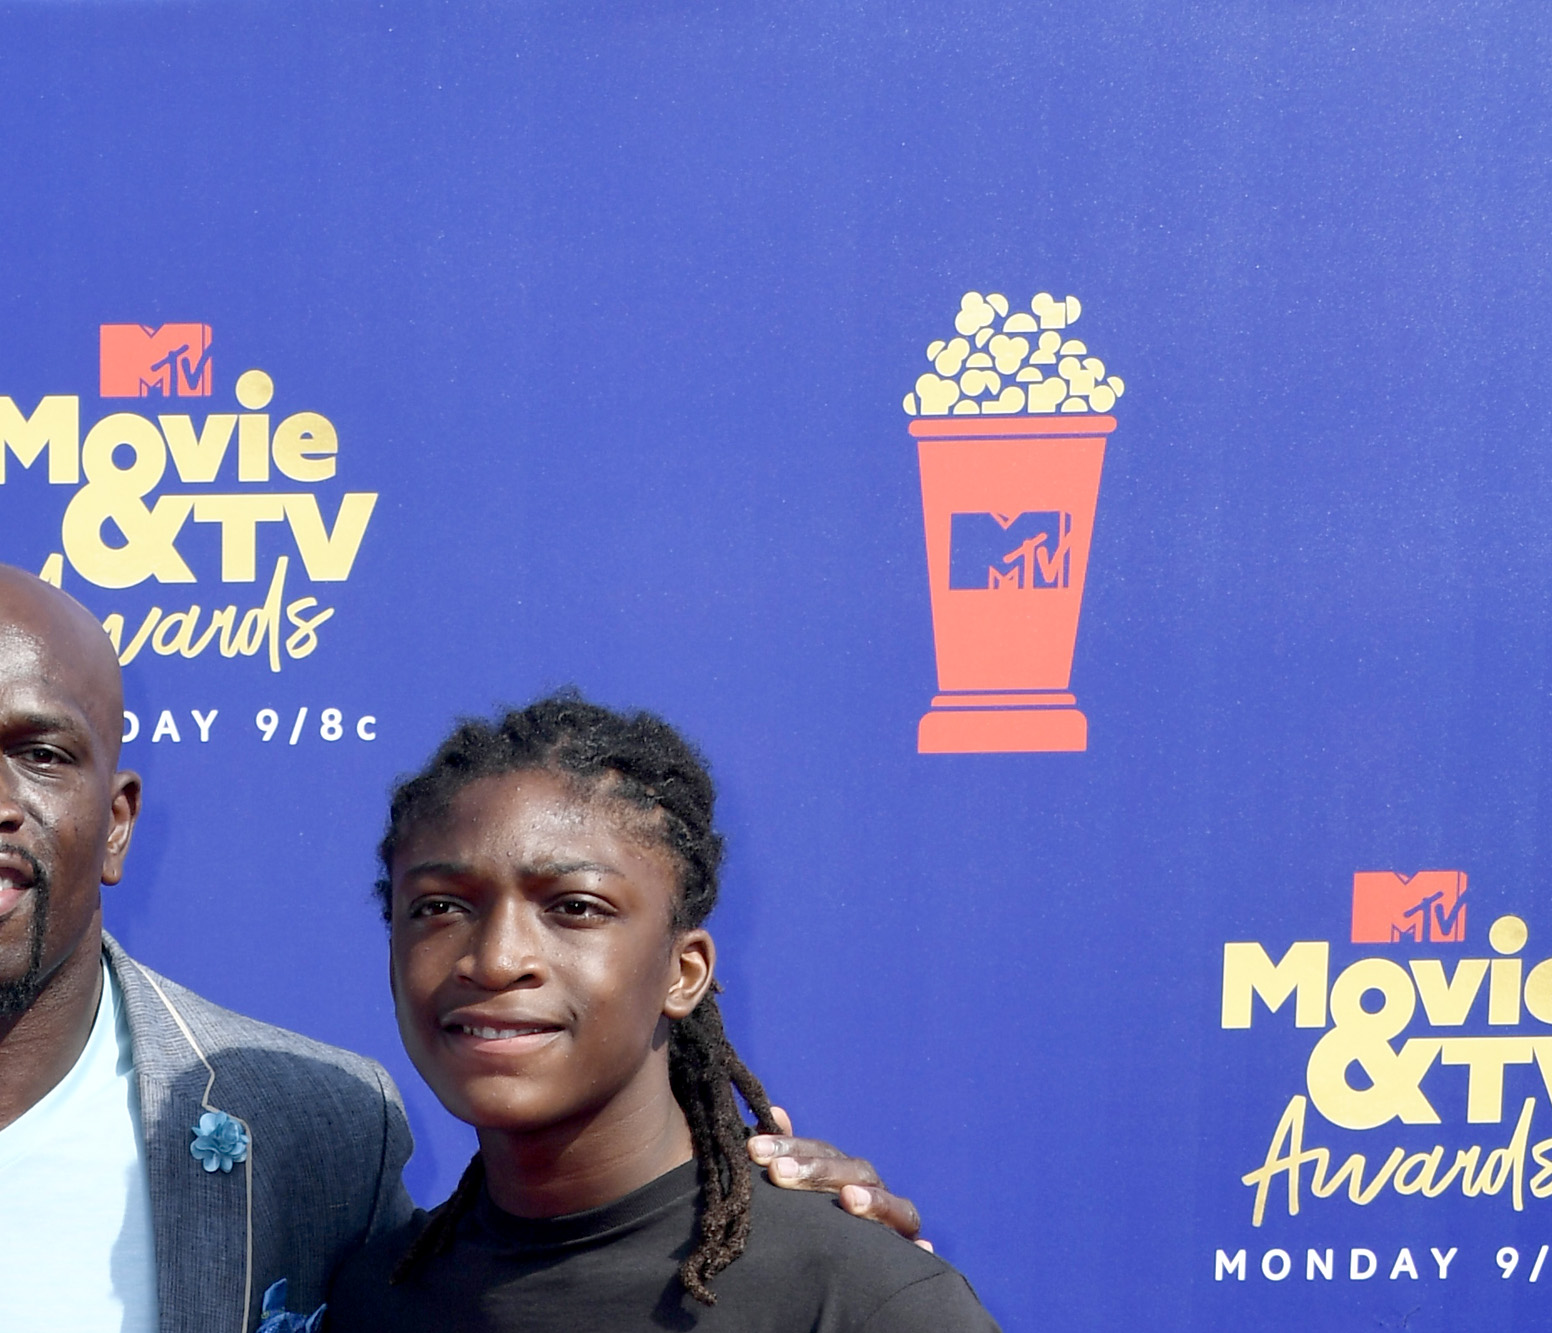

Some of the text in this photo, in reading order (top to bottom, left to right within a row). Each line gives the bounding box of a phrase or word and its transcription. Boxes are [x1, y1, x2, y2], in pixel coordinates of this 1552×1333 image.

[99, 322, 213, 398] MTV
[62, 493, 379, 589] &TV
[950, 512, 1072, 590] MTV
[122, 706, 377, 746] DAY 9/8c
[1350, 870, 1469, 944] MTV
[1307, 1036, 1552, 1131] &T
[1215, 1244, 1550, 1284] MONDAY 9/
